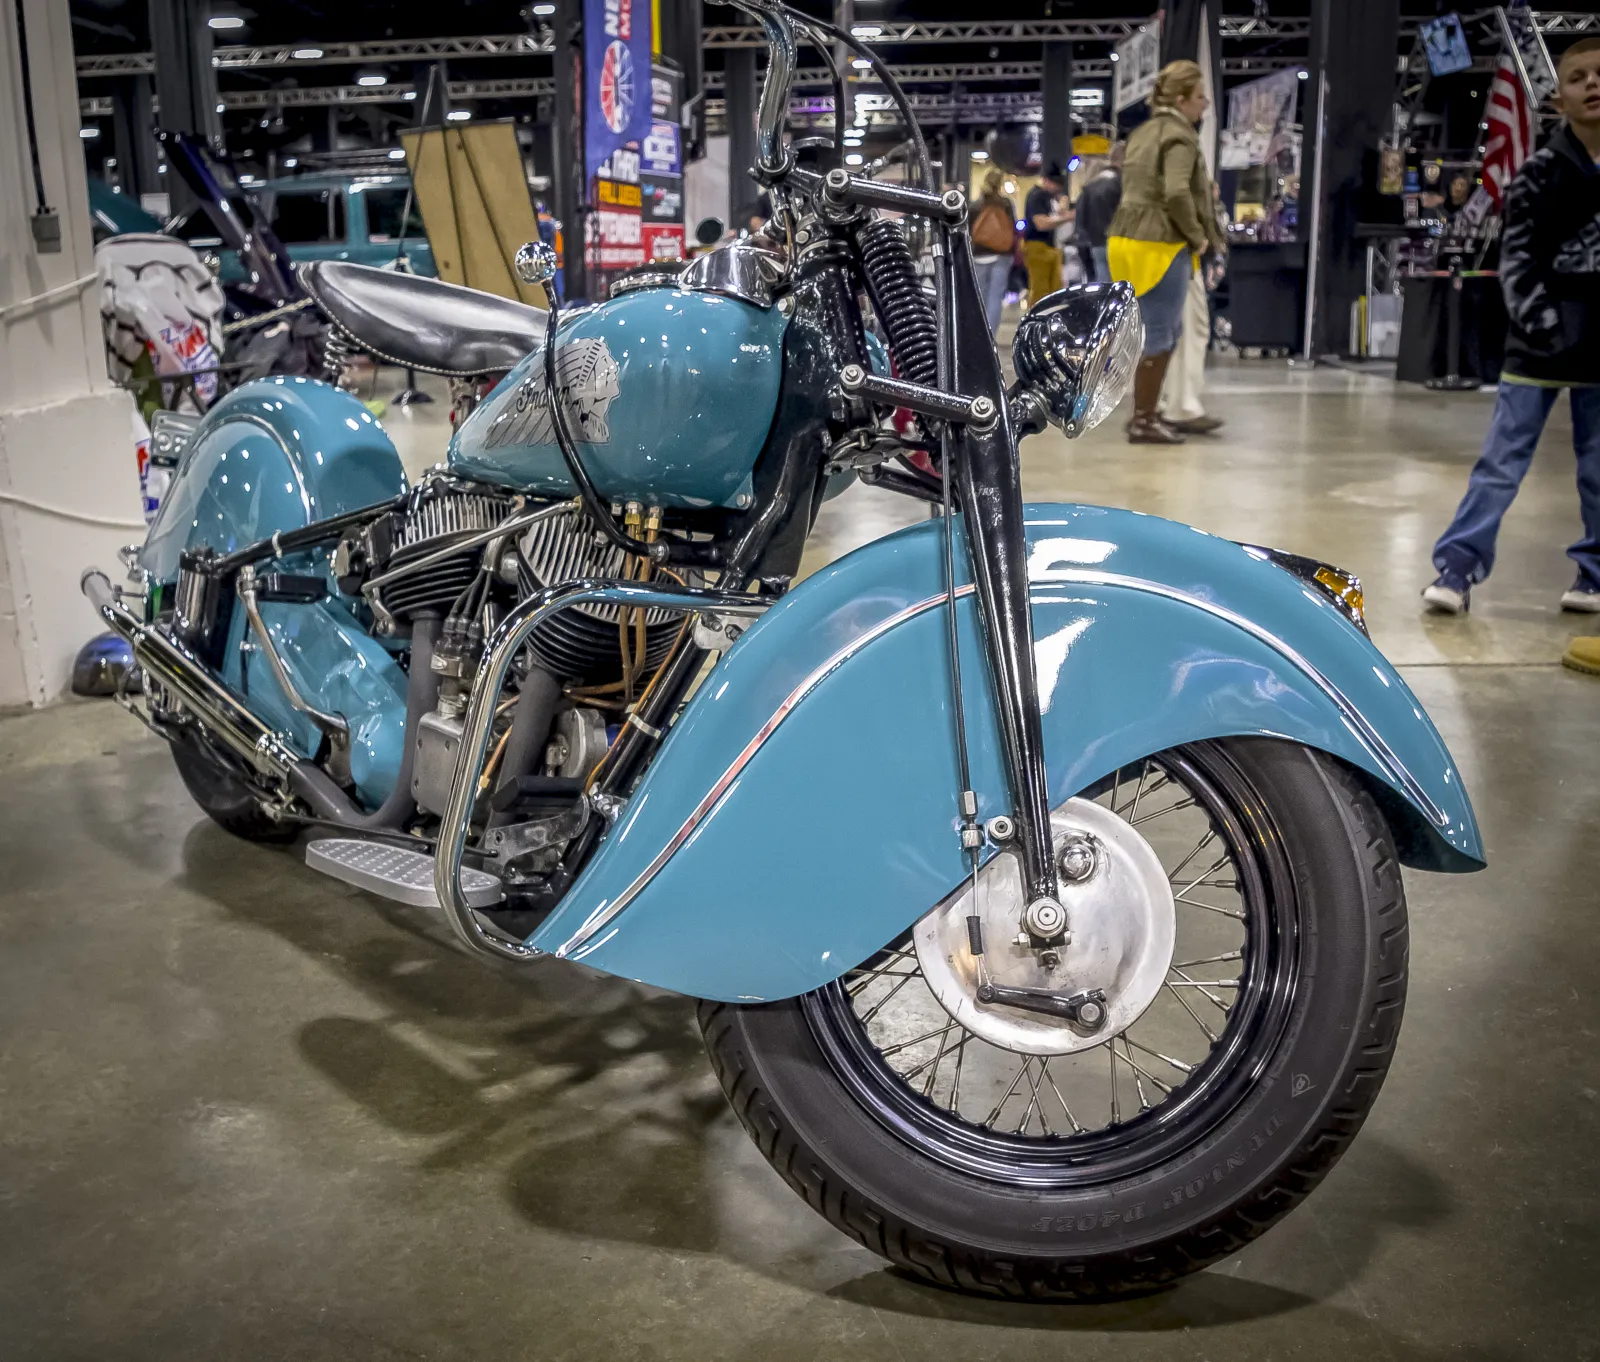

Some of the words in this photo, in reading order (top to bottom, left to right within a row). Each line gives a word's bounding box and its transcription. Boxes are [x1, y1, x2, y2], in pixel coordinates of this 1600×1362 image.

[515, 376, 571, 414] Indn
[1163, 1109, 1283, 1210] DUNLOP
[1031, 1202, 1146, 1233] D402F
